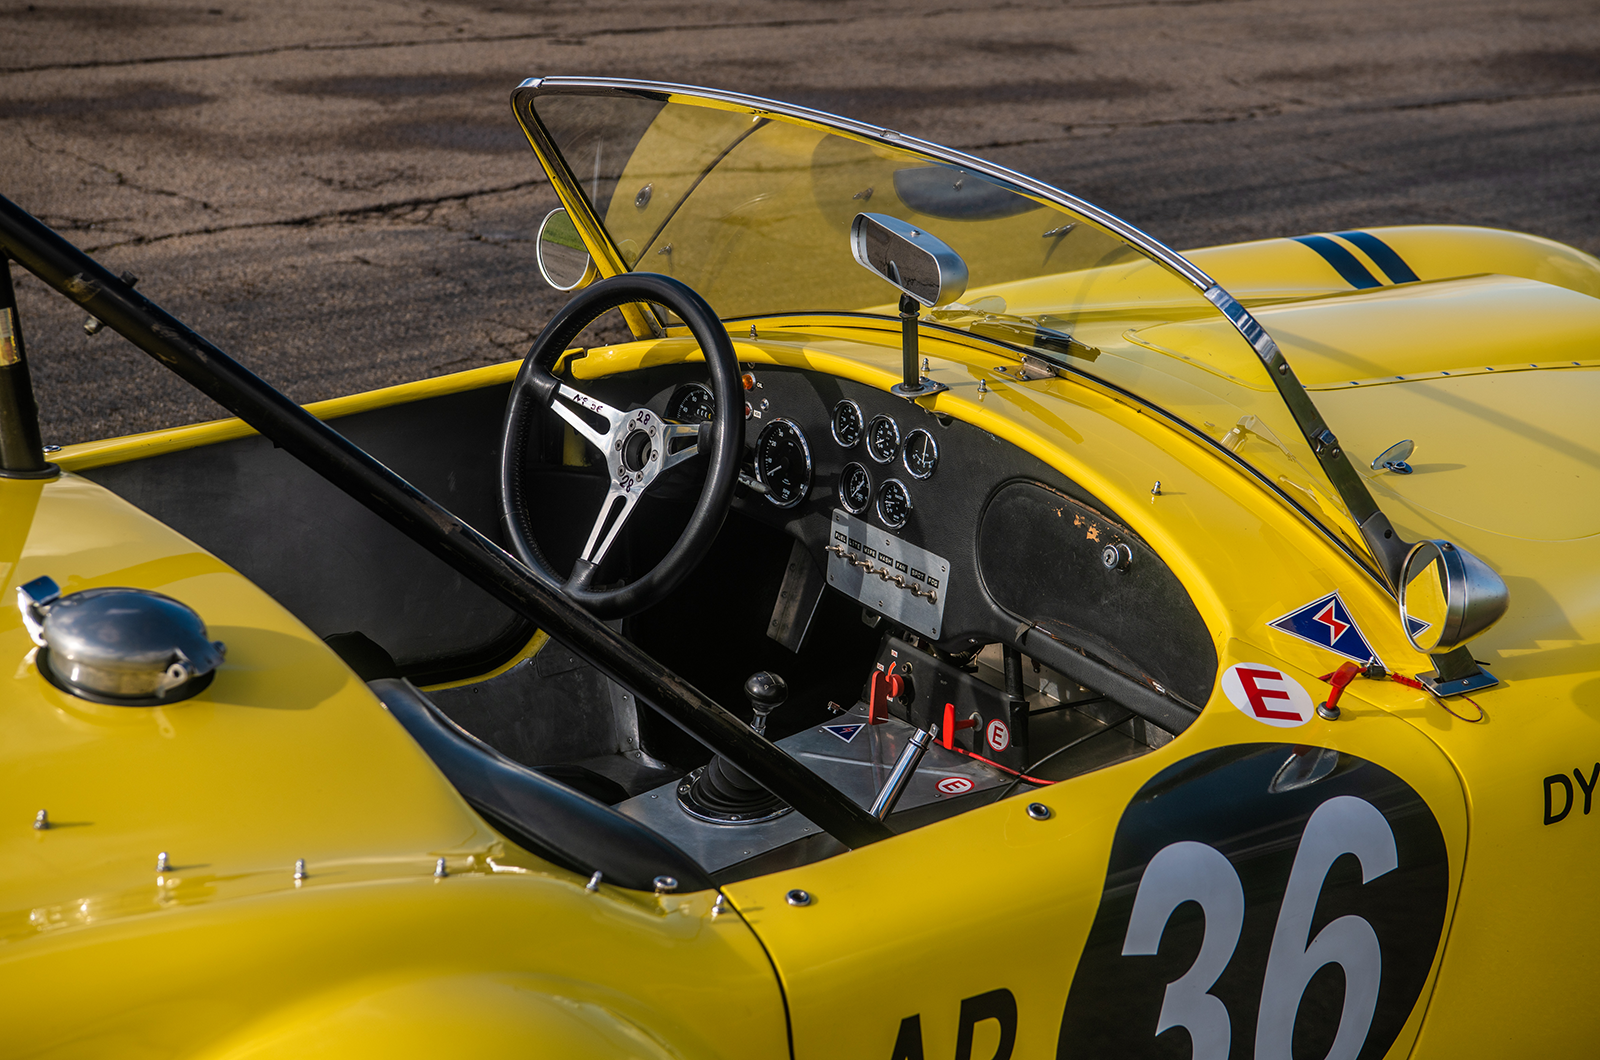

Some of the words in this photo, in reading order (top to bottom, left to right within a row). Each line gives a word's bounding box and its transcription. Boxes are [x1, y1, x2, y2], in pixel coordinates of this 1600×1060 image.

[636, 411, 651, 426] 28
[619, 475, 634, 493] 28
[835, 532, 847, 542] FUEL
[849, 539, 861, 550] LITE
[863, 546, 876, 557] WIPE
[879, 553, 893, 565] WASH
[896, 561, 907, 572] FAN
[911, 569, 925, 580] SPOT
[928, 576, 939, 588] FOG
[1235, 667, 1303, 722] E
[992, 725, 1004, 747] E
[942, 779, 967, 792] E
[1544, 761, 1600, 826] DY
[1121, 795, 1398, 1060] 36
